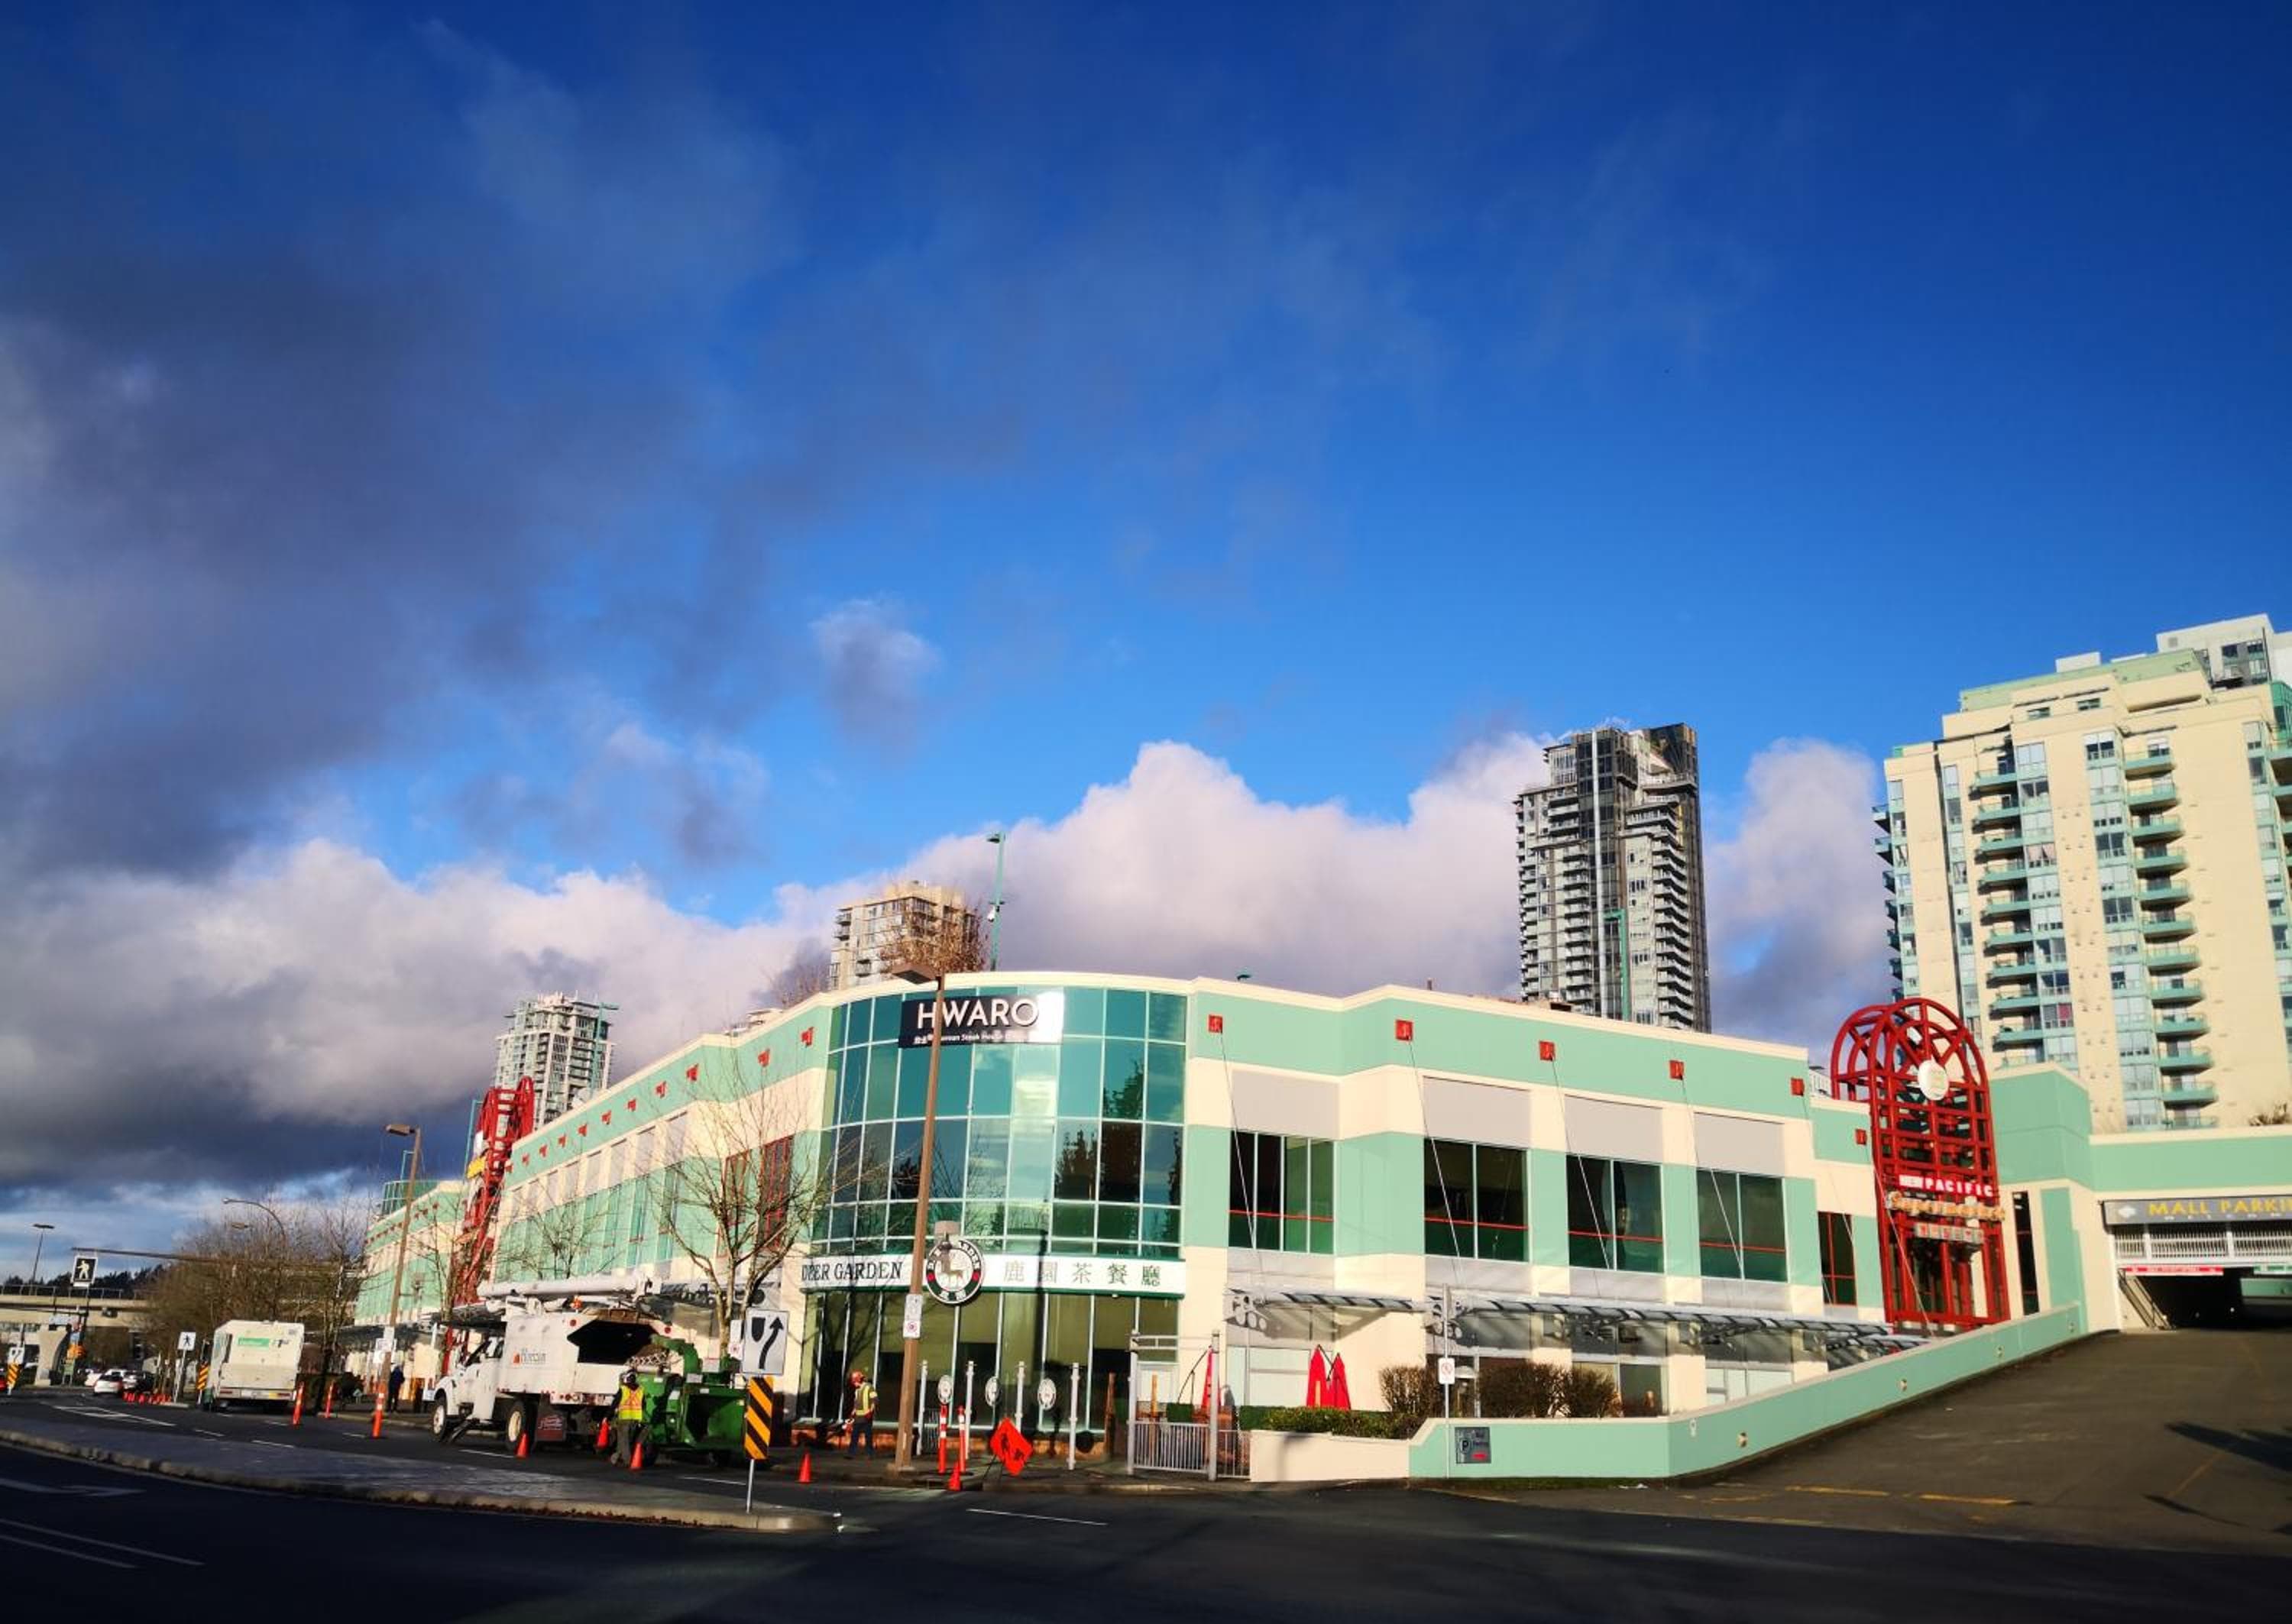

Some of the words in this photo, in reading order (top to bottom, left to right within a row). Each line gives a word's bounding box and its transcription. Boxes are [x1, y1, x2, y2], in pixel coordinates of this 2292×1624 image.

[918, 998, 1039, 1029] HWARO
[1925, 1178, 1993, 1197] PACIFIC
[2148, 1202, 2212, 1216] MALL
[834, 1261, 903, 1280] GARDEN
